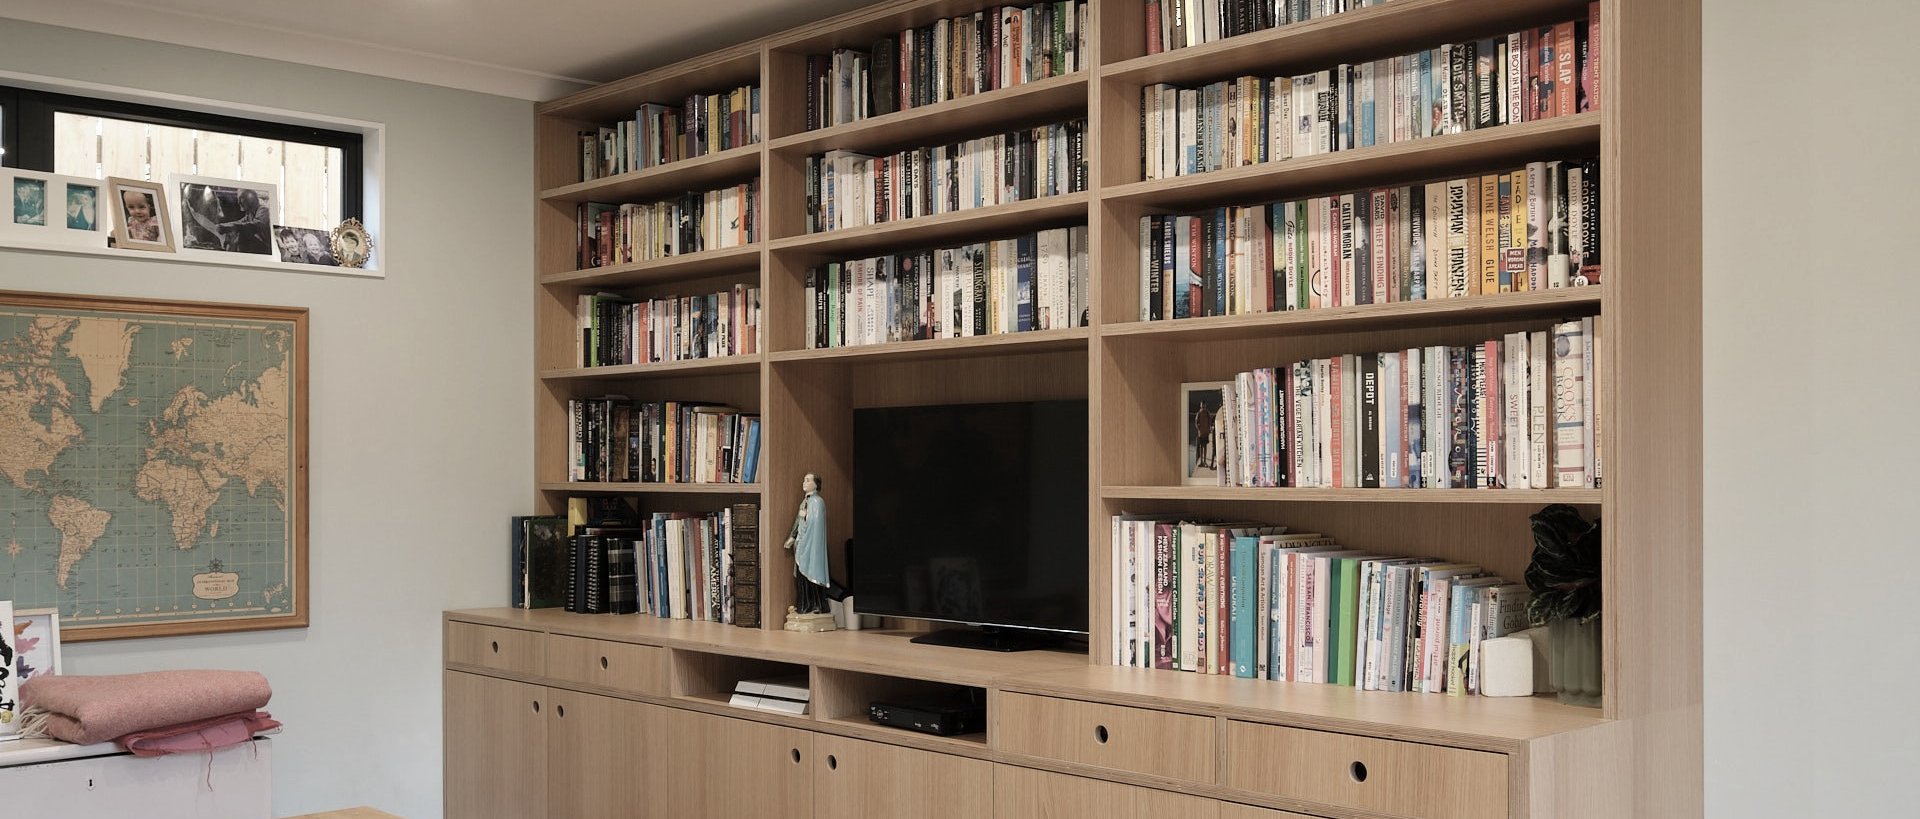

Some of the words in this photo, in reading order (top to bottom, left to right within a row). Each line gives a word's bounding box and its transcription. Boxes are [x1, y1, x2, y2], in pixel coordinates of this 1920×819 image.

[1559, 28, 1571, 53] THE
[1453, 51, 1465, 82] ZADIE
[1512, 76, 1519, 86] IN
[1559, 53, 1571, 84] SLAP
[1453, 83, 1465, 119] SMITH
[1480, 94, 1491, 124] FRANZEN
[1450, 185, 1464, 234] JONATHAN
[1485, 181, 1494, 215] IRVINE
[1582, 180, 1590, 218] RODDY
[1342, 202, 1352, 231] CAITLIN
[1412, 208, 1421, 246] SURVIVORS
[1342, 232, 1352, 260] MORAN
[1376, 224, 1384, 247] THEFT
[1485, 218, 1494, 251] WELSH
[974, 262, 984, 303] STALINGRAD
[1150, 260, 1160, 293] WINTER
[1376, 256, 1384, 288] FINDING
[1451, 247, 1464, 291] FRANZEN
[1486, 259, 1494, 284] GLUE
[1365, 372, 1375, 405] DEPOT
[1556, 376, 1565, 422] BOOK
[1563, 366, 1577, 422] COOK'S
[1509, 394, 1518, 428] SWEET
[1532, 405, 1545, 444] PLEN
[1206, 554, 1216, 588] DRAW
[1487, 602, 1496, 630] Finding
[1499, 599, 1526, 615] Findin
[1503, 616, 1522, 630] Gobi
